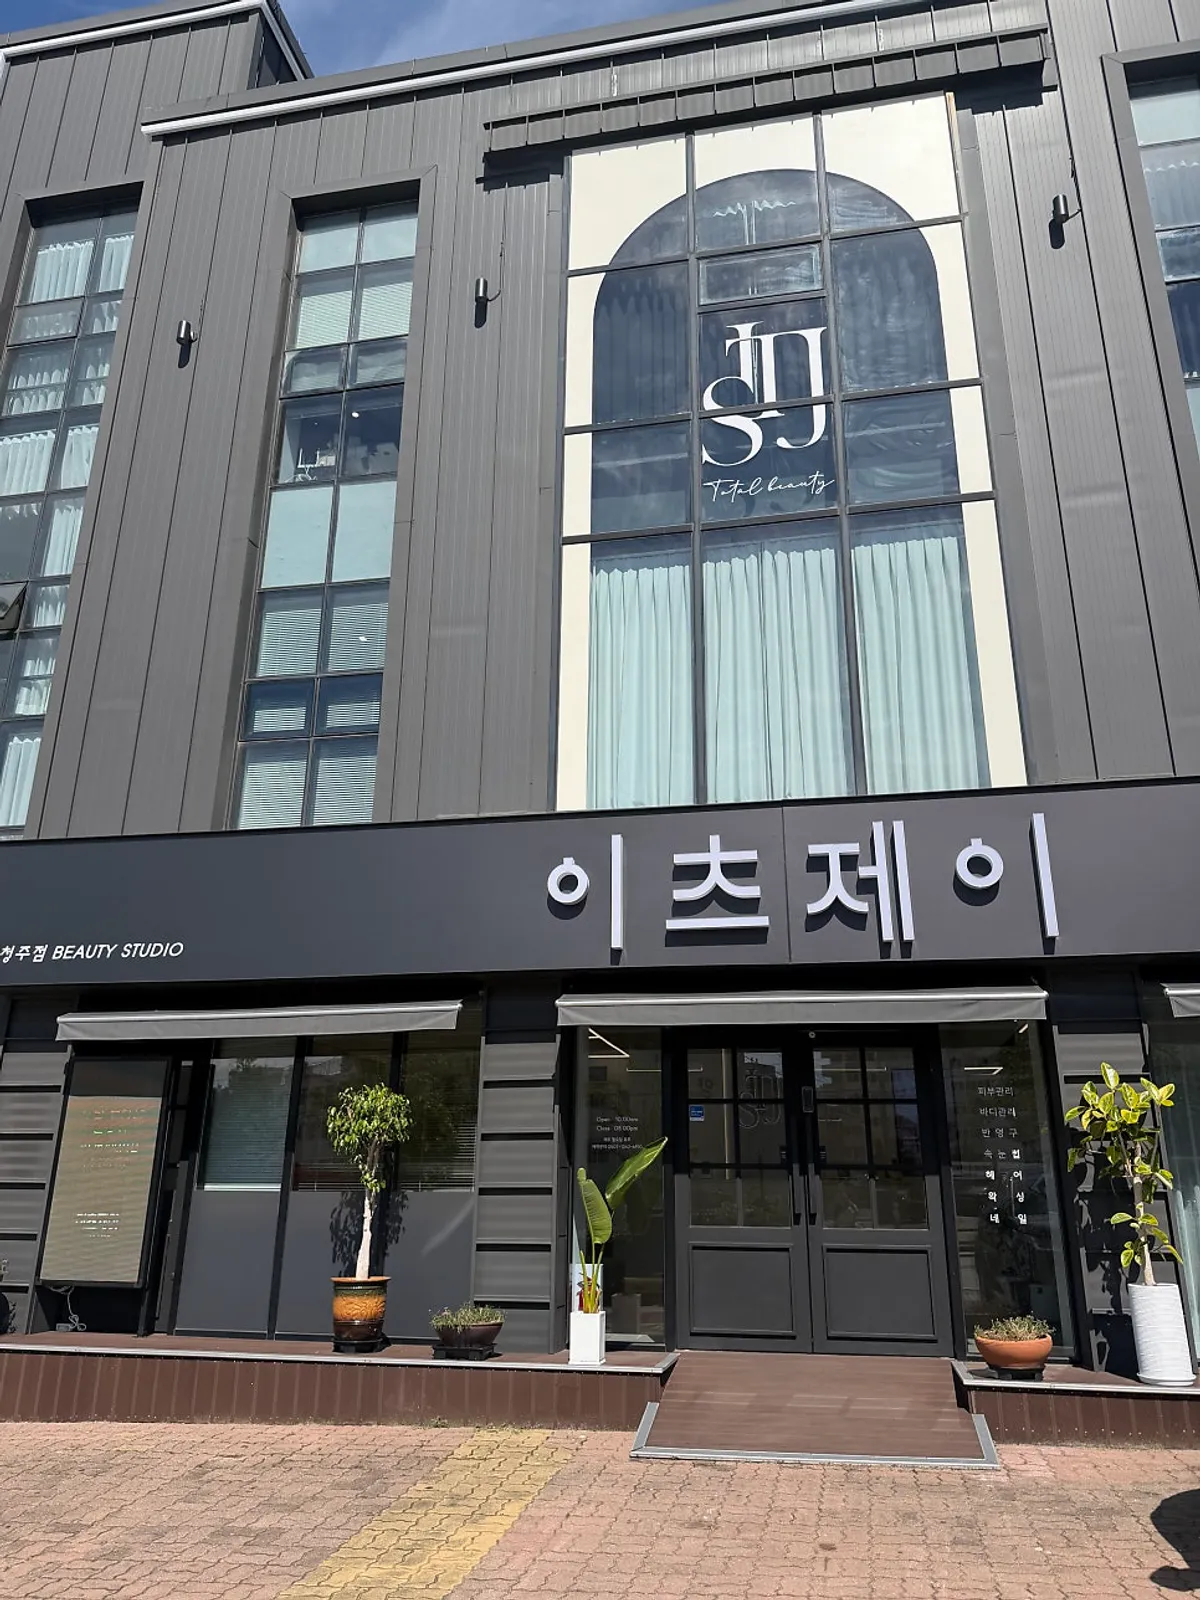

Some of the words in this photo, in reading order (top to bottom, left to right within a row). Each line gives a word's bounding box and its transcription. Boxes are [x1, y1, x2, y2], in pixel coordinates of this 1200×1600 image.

[702, 476, 764, 503] Total
[767, 471, 835, 496] beauty
[547, 813, 1059, 950] 이츠제이
[0, 944, 49, 963] 청주점
[52, 944, 118, 960] BEAUTY
[121, 942, 184, 958] STUDIO
[977, 1086, 1014, 1097] 피부관리
[979, 1106, 1017, 1117] 바디관리
